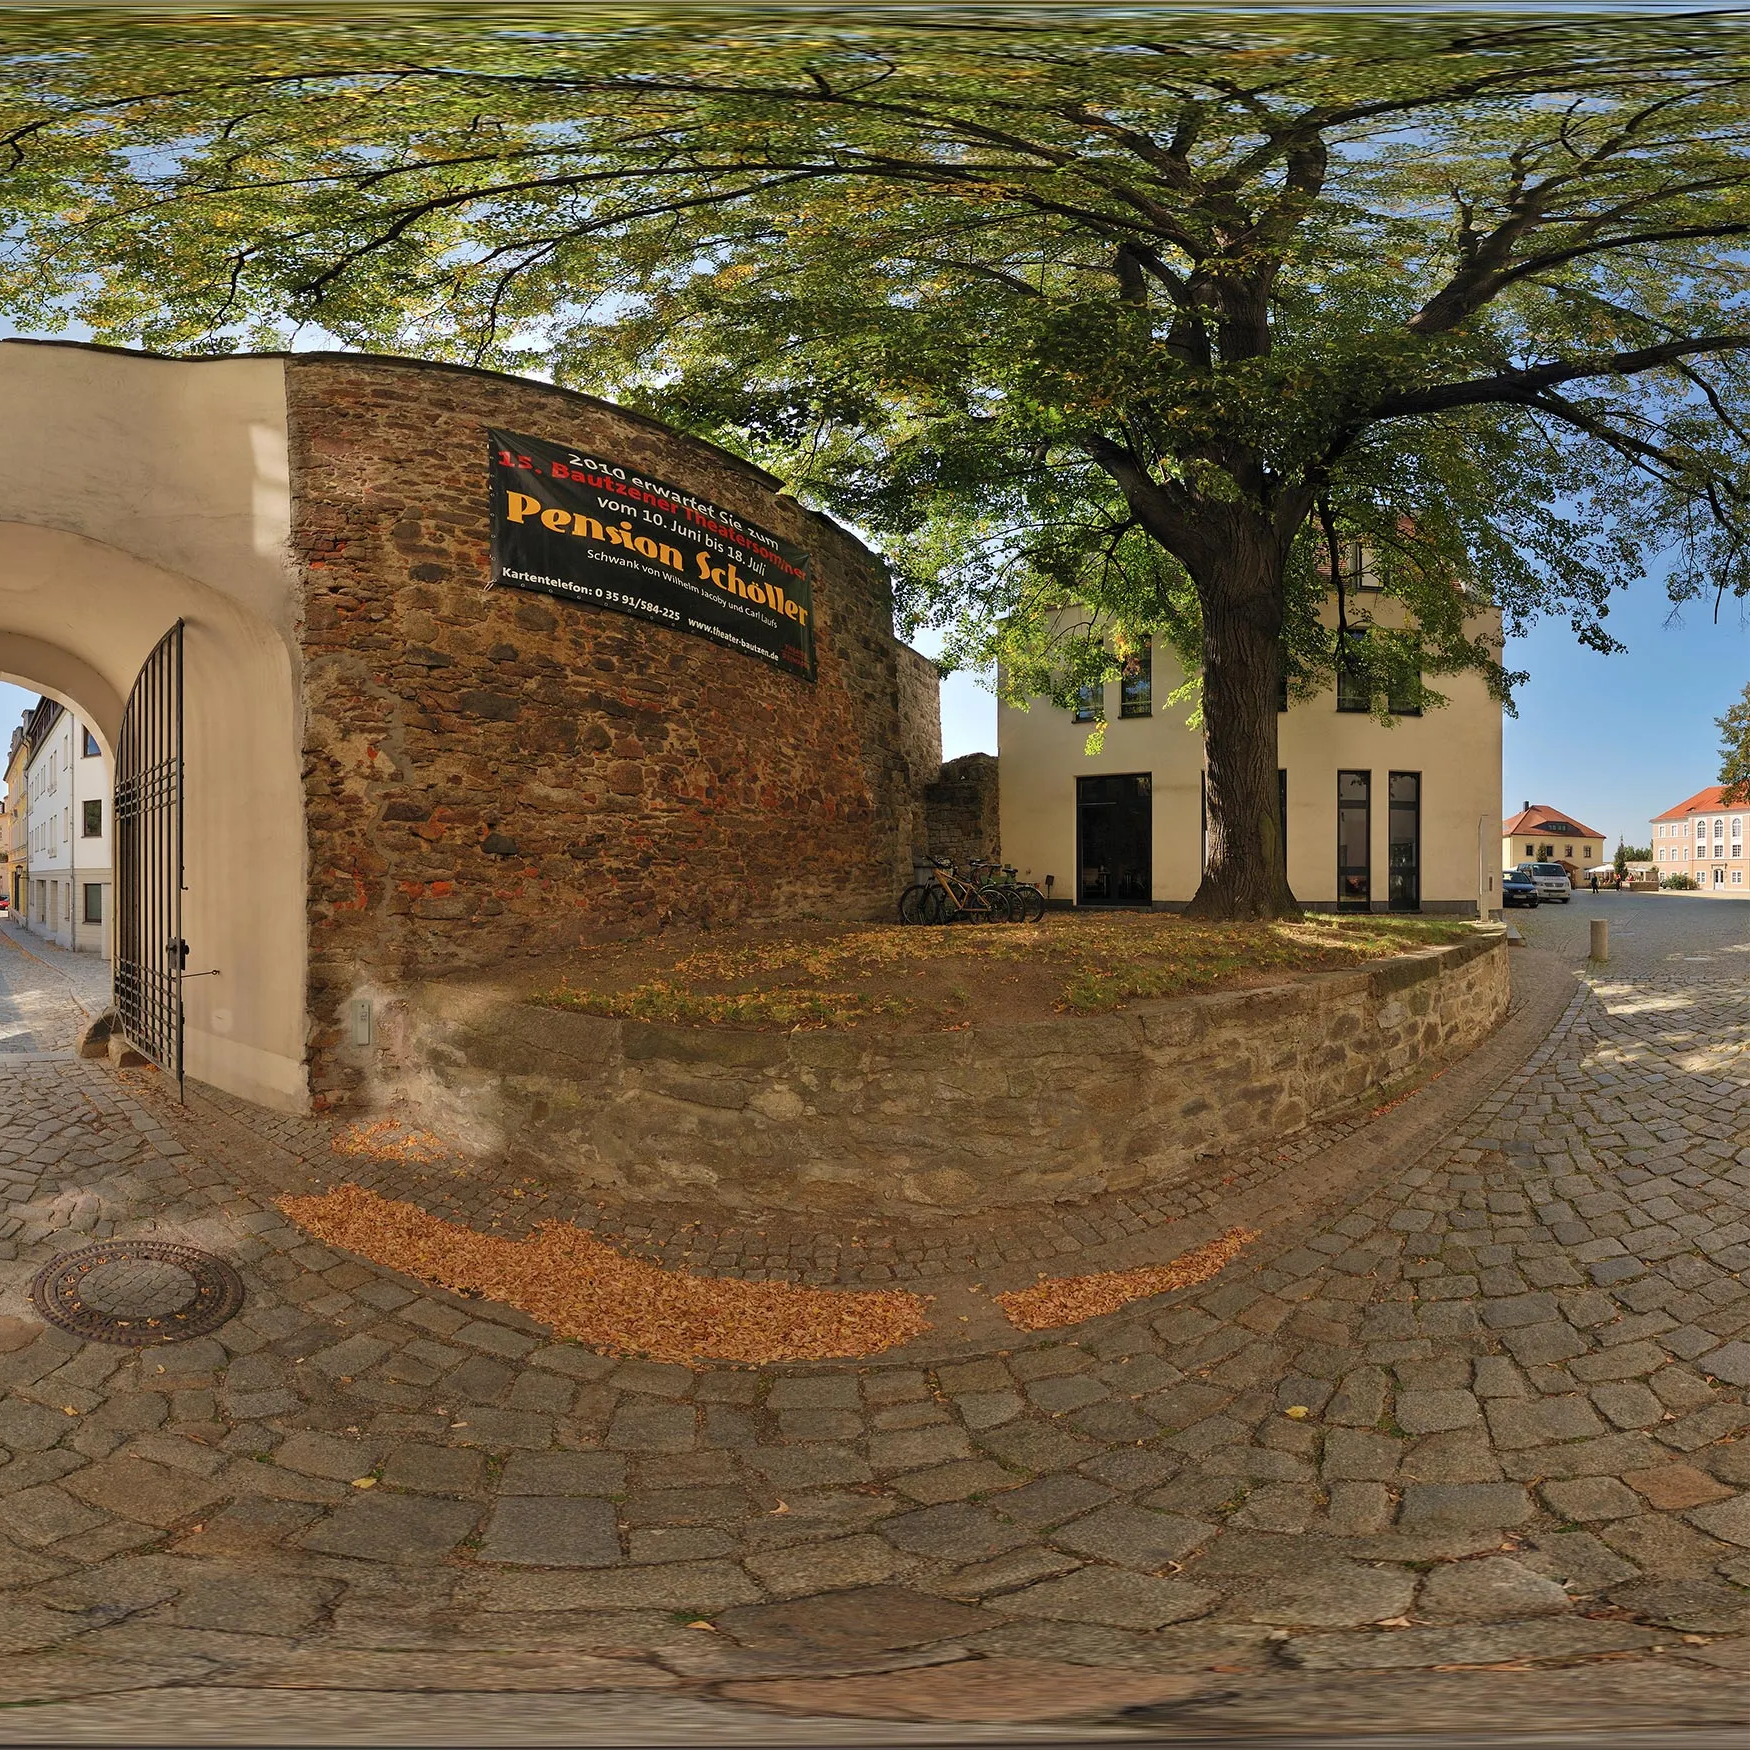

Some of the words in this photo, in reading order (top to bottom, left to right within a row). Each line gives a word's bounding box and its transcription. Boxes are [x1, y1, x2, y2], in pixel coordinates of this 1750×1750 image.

[498, 450, 542, 475] 15.
[552, 461, 679, 514] Bautzener
[568, 453, 626, 480] 2010
[631, 476, 716, 519] erwartet
[719, 511, 742, 532] Sie
[748, 527, 779, 550] zum
[506, 490, 684, 572] Pension
[696, 551, 809, 627] Schöller
[597, 497, 637, 518] vom
[643, 510, 667, 529] 10.
[671, 520, 701, 543] Juni
[706, 534, 724, 553] bis
[728, 546, 745, 565] 18.
[747, 557, 767, 577] Juli
[502, 567, 592, 596] Kartentelefon:
[595, 588, 603, 598] 0
[605, 590, 619, 602] 35
[621, 594, 681, 621] 91/584-225
[688, 618, 779, 662] www.theater-bautzen.de
[587, 549, 640, 570] Schwank
[641, 565, 661, 577] von
[662, 571, 700, 594] Wilhelm
[701, 588, 727, 608] Jacoby
[728, 601, 744, 613] und
[745, 607, 761, 621] Carl
[761, 613, 778, 629] Laufs
